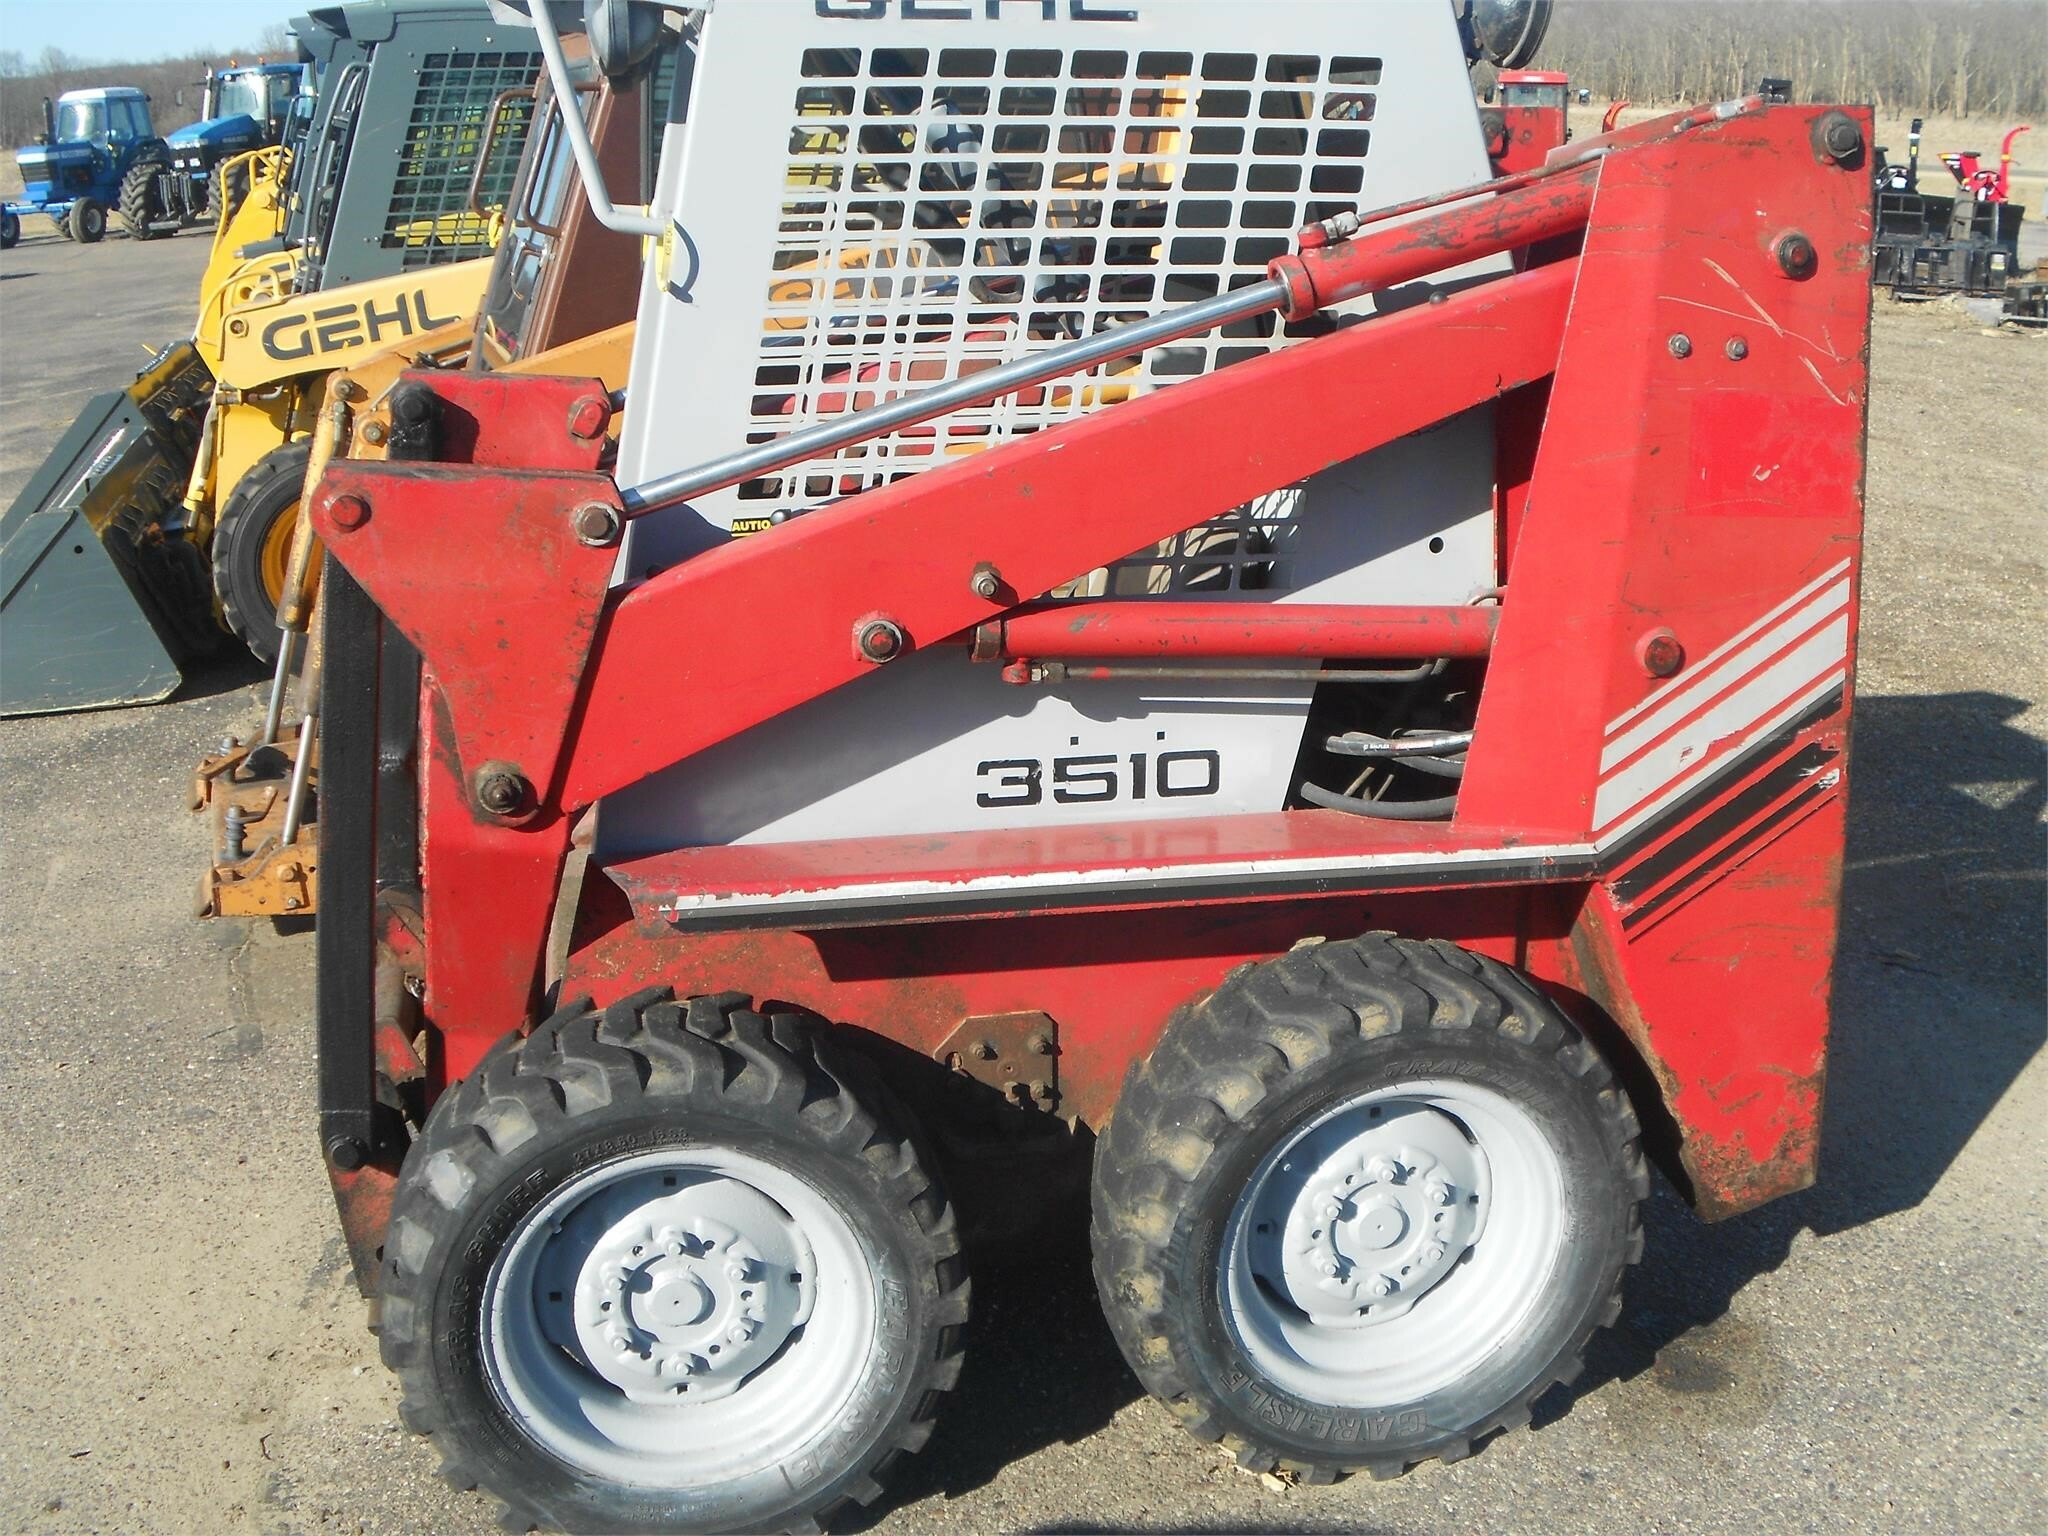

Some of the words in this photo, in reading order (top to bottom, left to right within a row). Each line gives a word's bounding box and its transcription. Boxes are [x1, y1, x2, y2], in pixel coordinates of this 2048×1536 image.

[262, 289, 461, 360] GEHL
[732, 519, 773, 532] AUTIO
[977, 750, 1220, 808] 3510
[447, 1275, 471, 1377] TRAC
[464, 1168, 549, 1264] CHIEF
[791, 1278, 910, 1490] CARLISLE
[1220, 1361, 1428, 1442] CARLISLE
